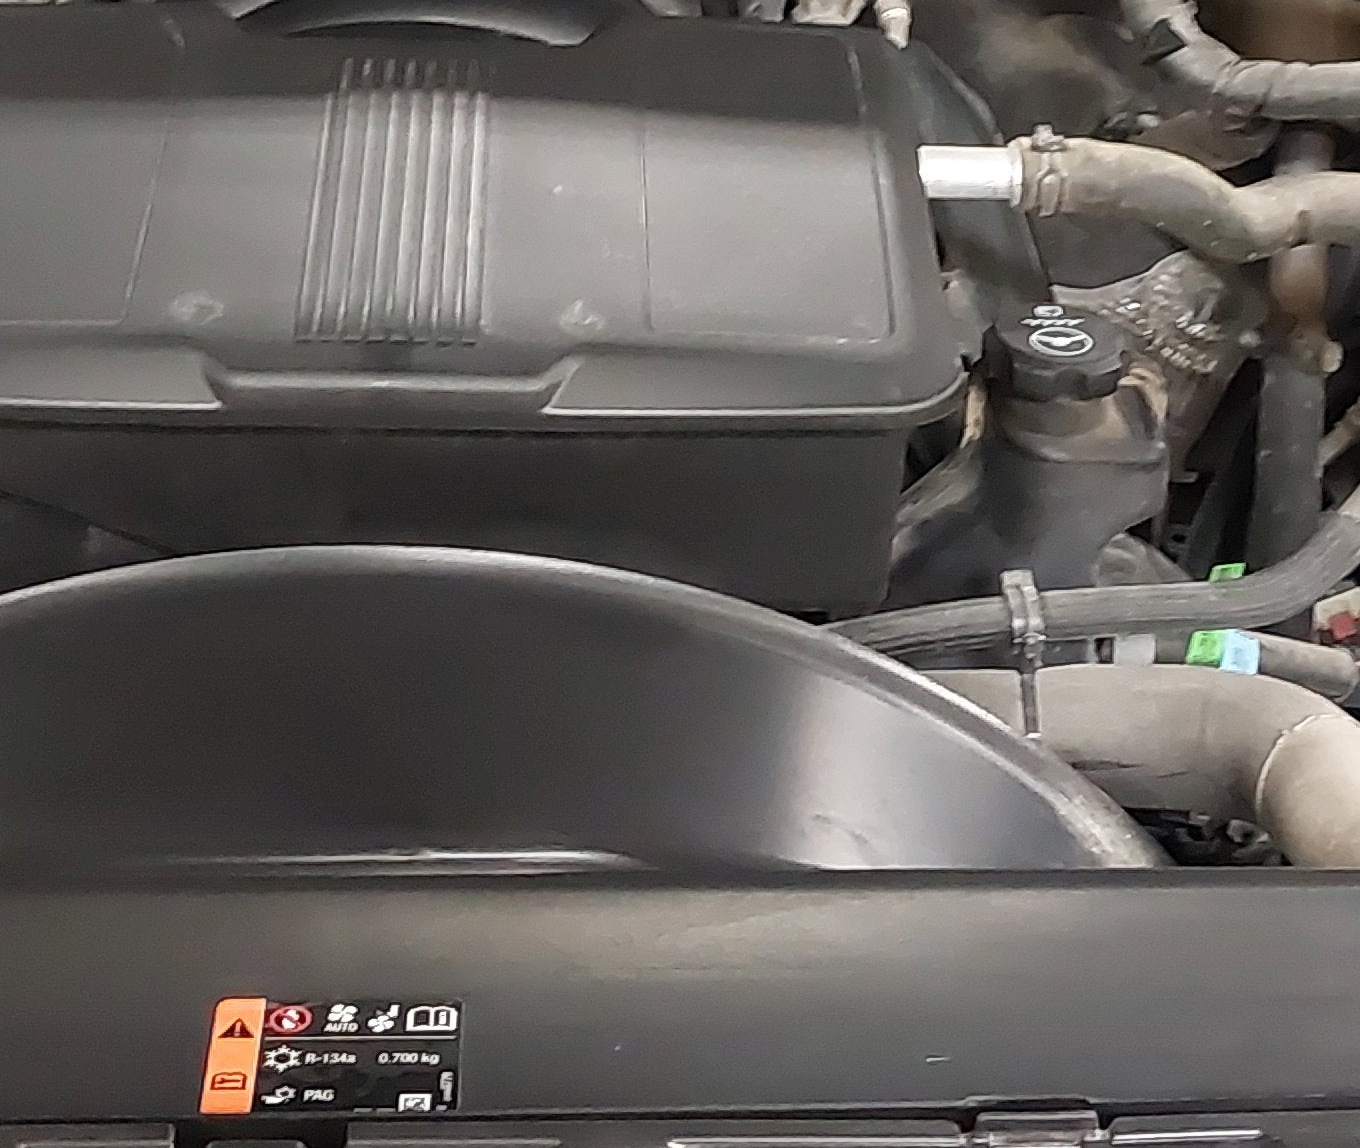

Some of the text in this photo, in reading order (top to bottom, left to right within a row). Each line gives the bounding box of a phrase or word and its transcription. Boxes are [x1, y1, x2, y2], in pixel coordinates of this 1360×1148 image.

[324, 1022, 359, 1033] AUTO
[304, 1053, 441, 1065] R-134a 0.700 kg
[303, 1089, 335, 1102] PAG
